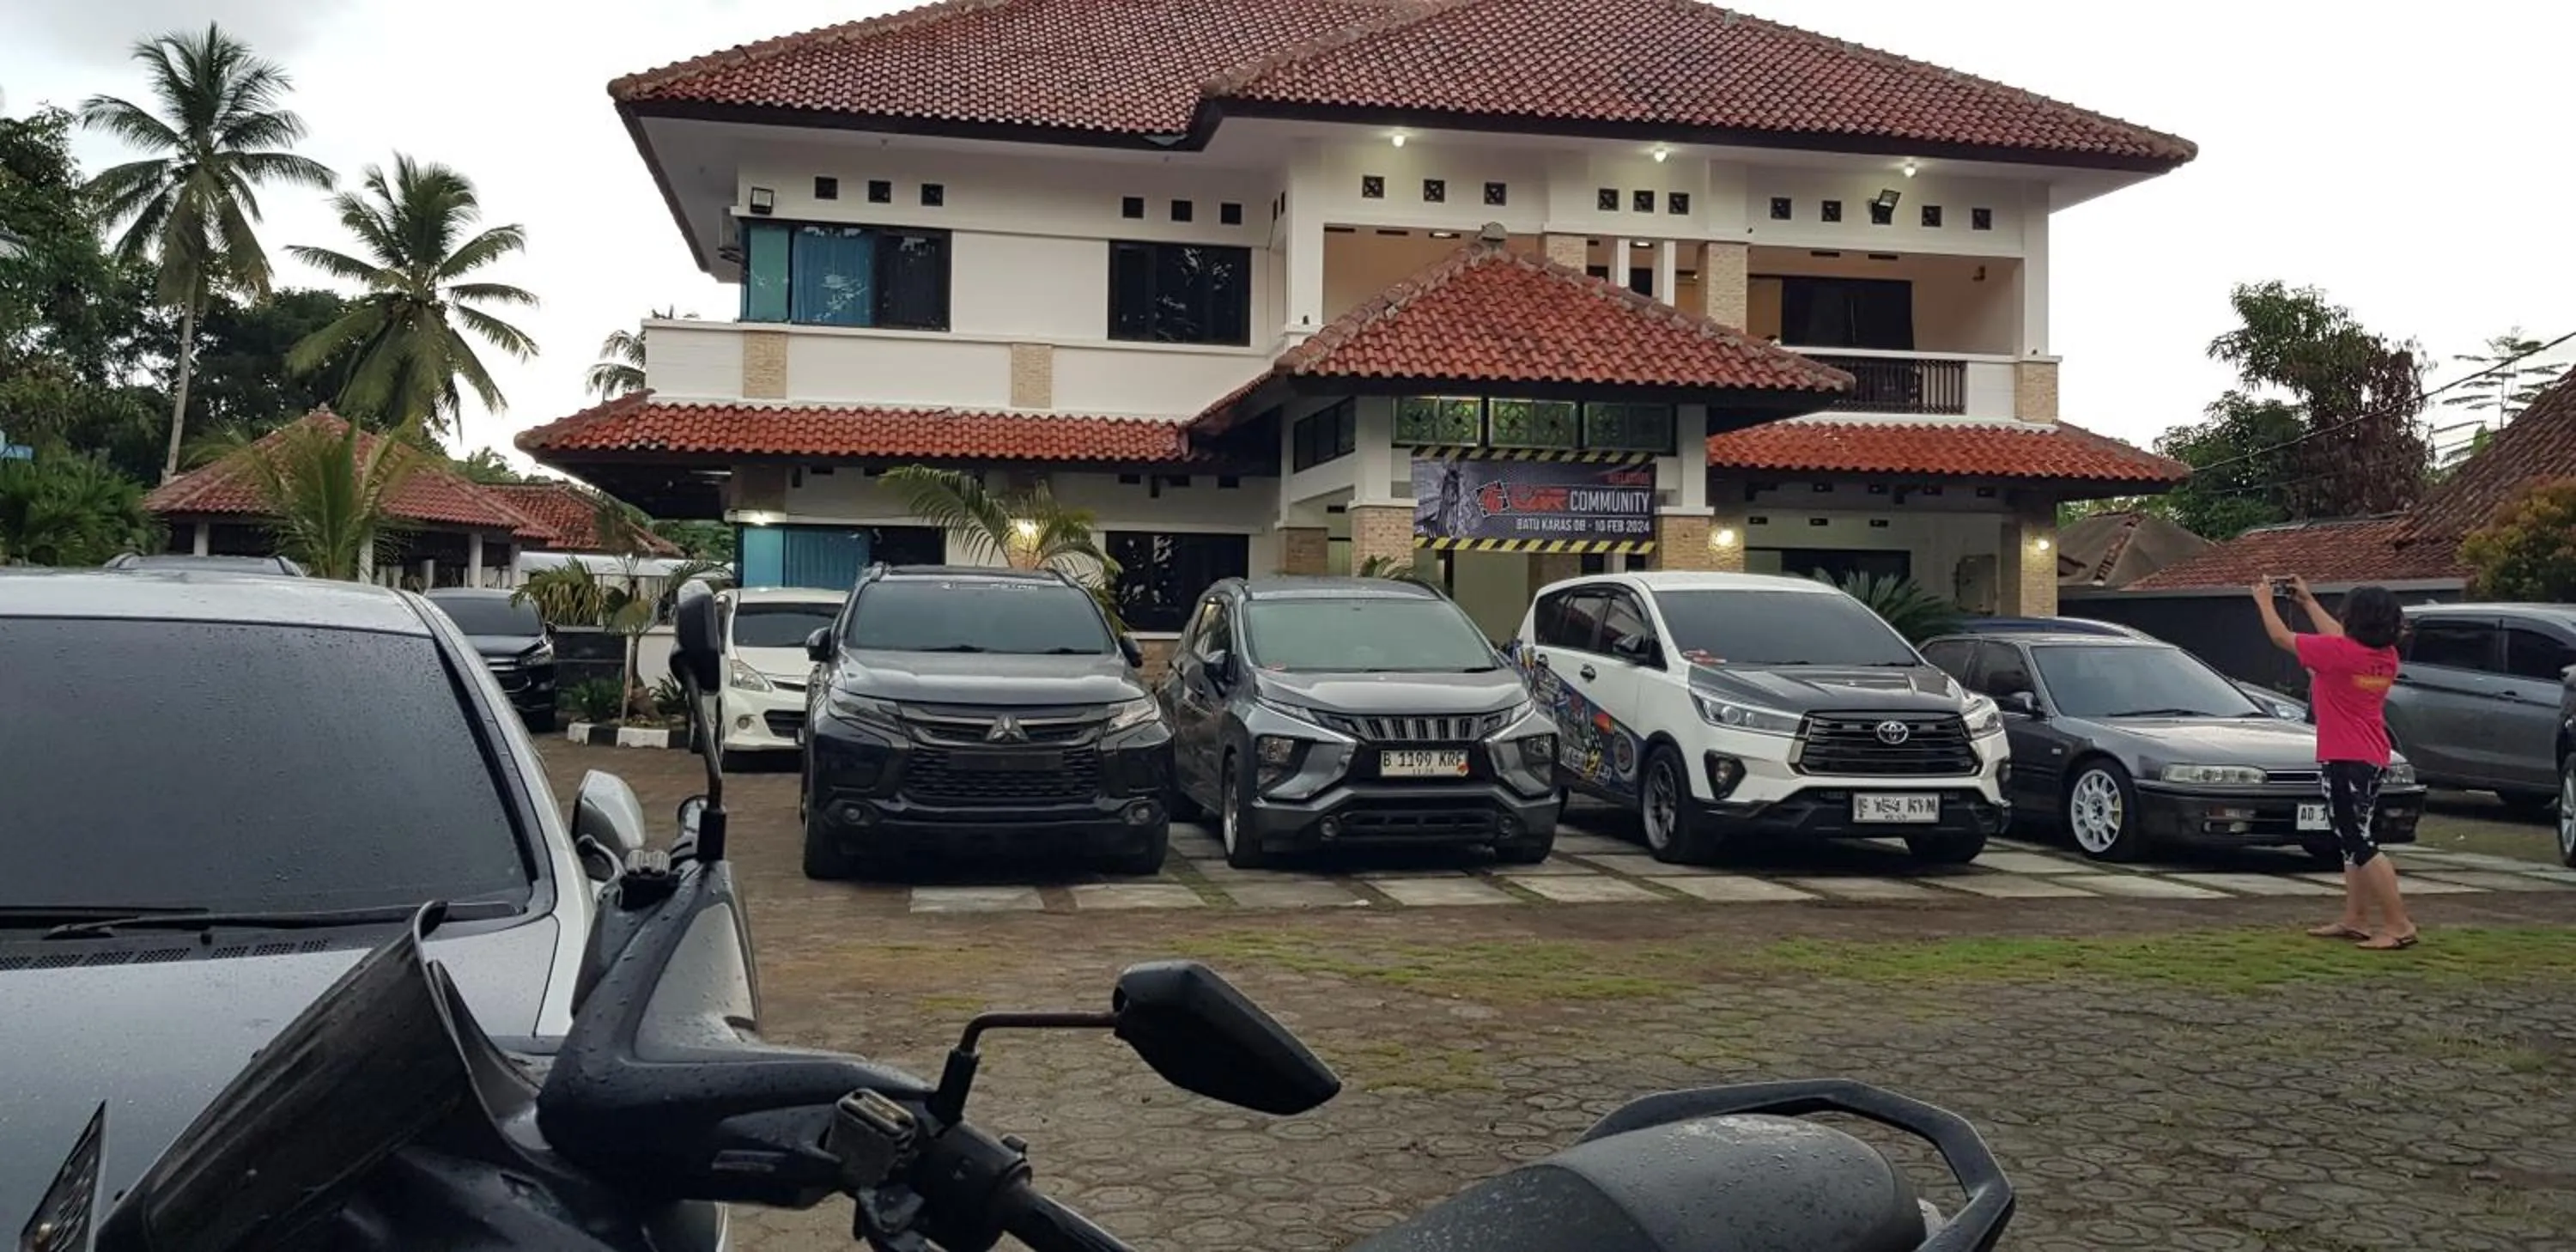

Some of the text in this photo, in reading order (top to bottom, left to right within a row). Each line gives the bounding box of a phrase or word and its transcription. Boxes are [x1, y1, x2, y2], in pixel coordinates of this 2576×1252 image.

[1570, 490, 1649, 513] COMMUNITY
[1516, 518, 1540, 530] BATU
[1541, 519, 1572, 531] KARAS
[1607, 520, 1625, 532] FEB
[1626, 520, 1649, 532] 2024
[1383, 751, 1391, 767] B
[1398, 751, 1433, 767] 1199
